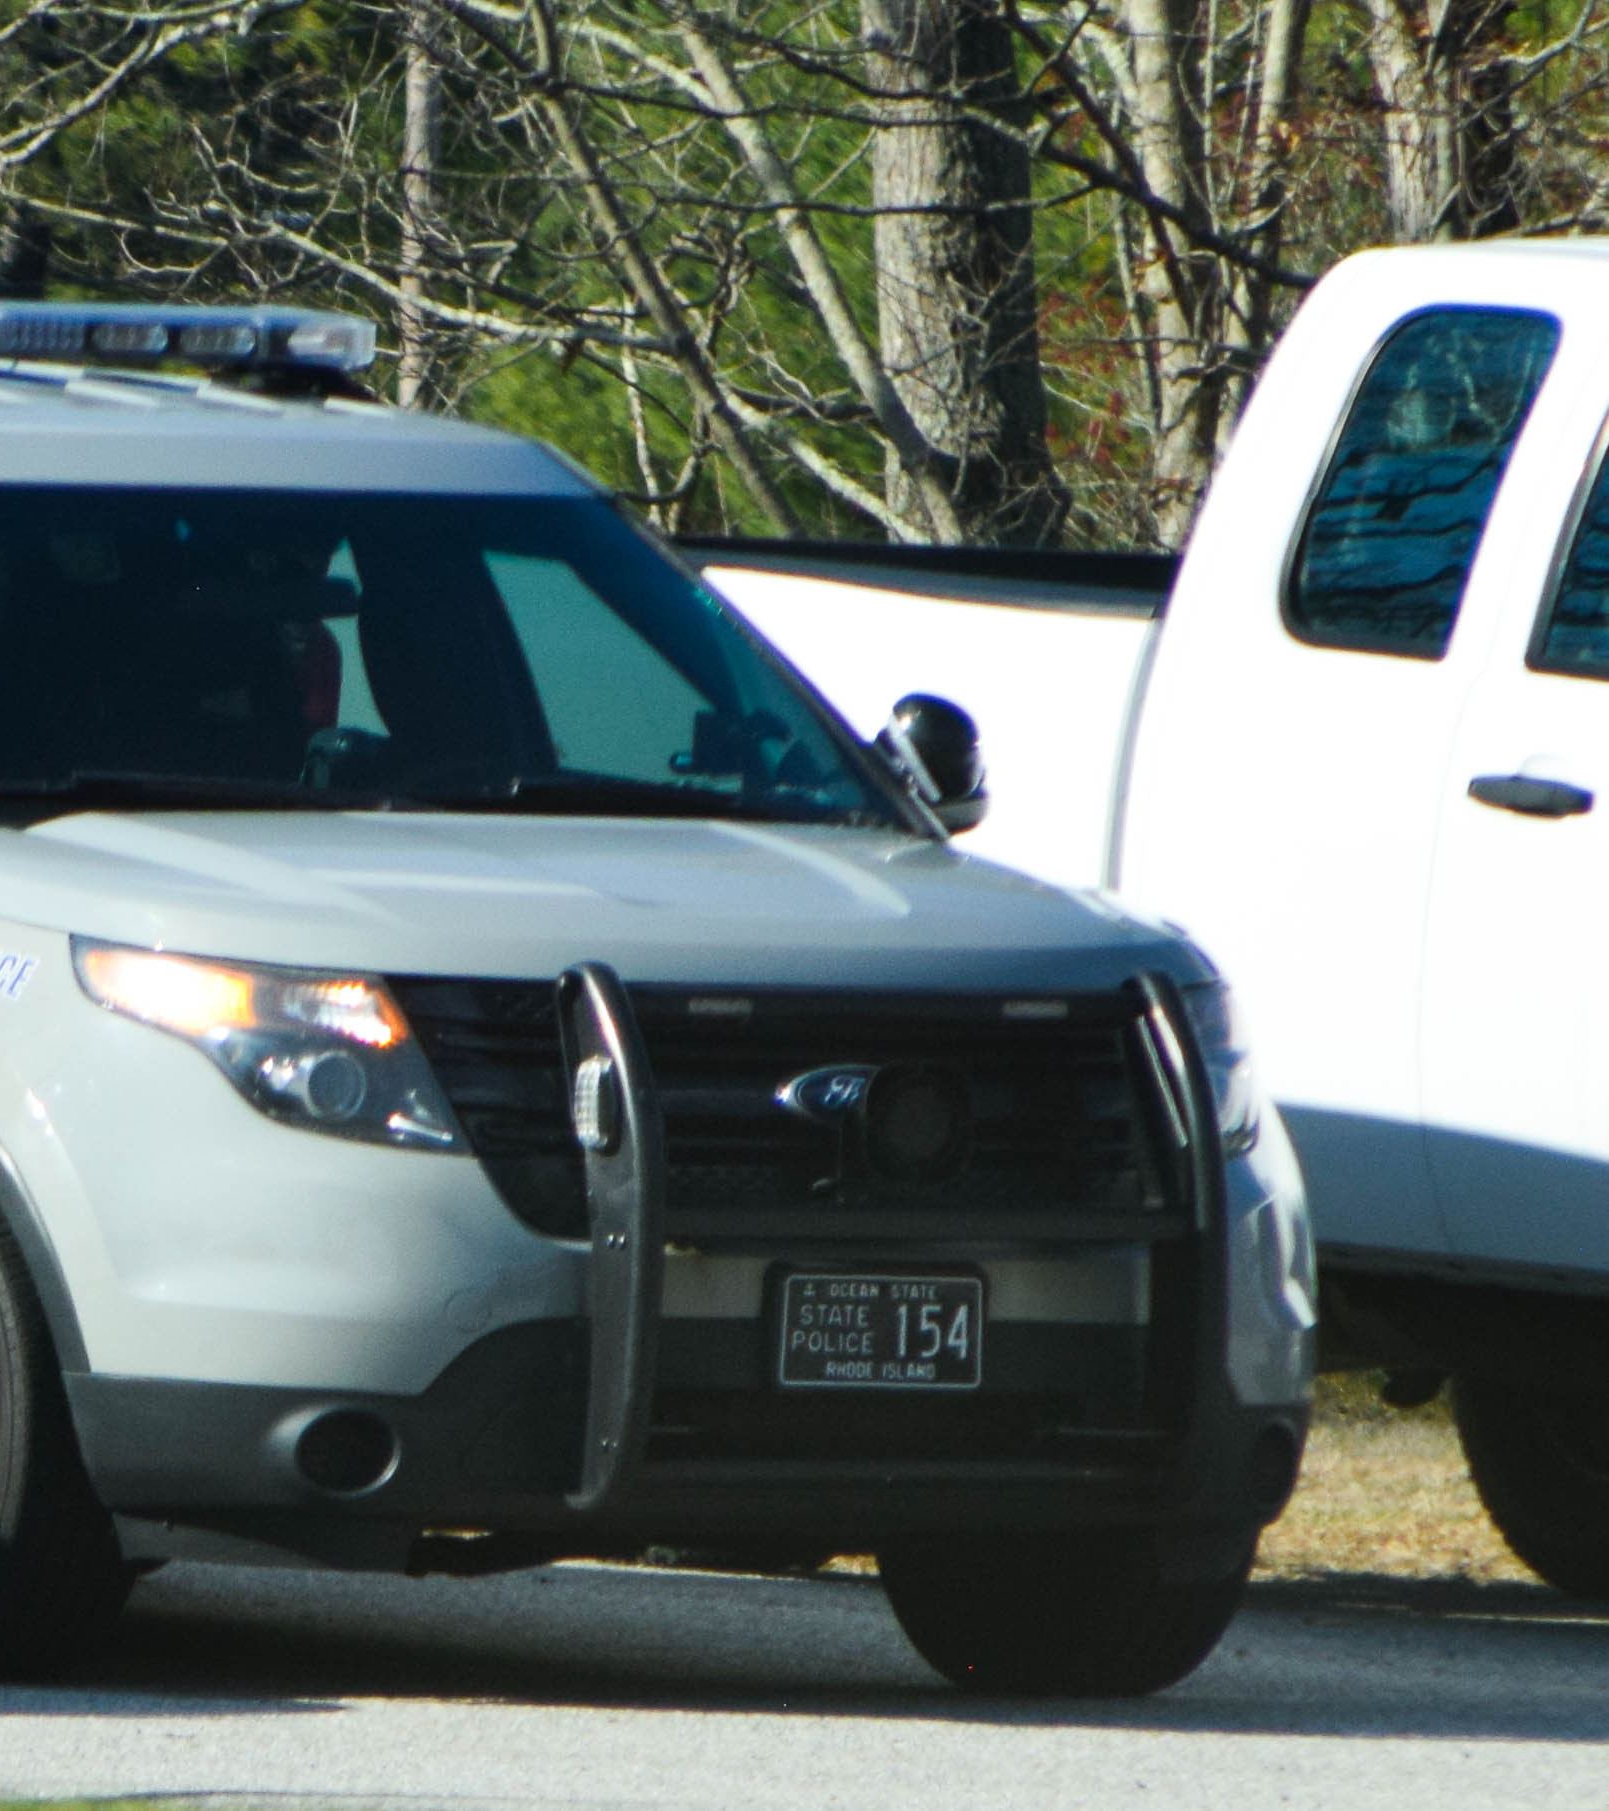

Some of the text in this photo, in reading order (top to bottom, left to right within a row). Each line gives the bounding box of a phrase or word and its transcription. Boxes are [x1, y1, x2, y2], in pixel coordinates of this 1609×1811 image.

[829, 1282, 938, 1300] OCEAN STATE
[799, 1303, 870, 1328] STATE
[791, 1330, 875, 1355] POLICE
[896, 1303, 970, 1360] 154
[825, 1360, 937, 1381] RHODE ISLAND
